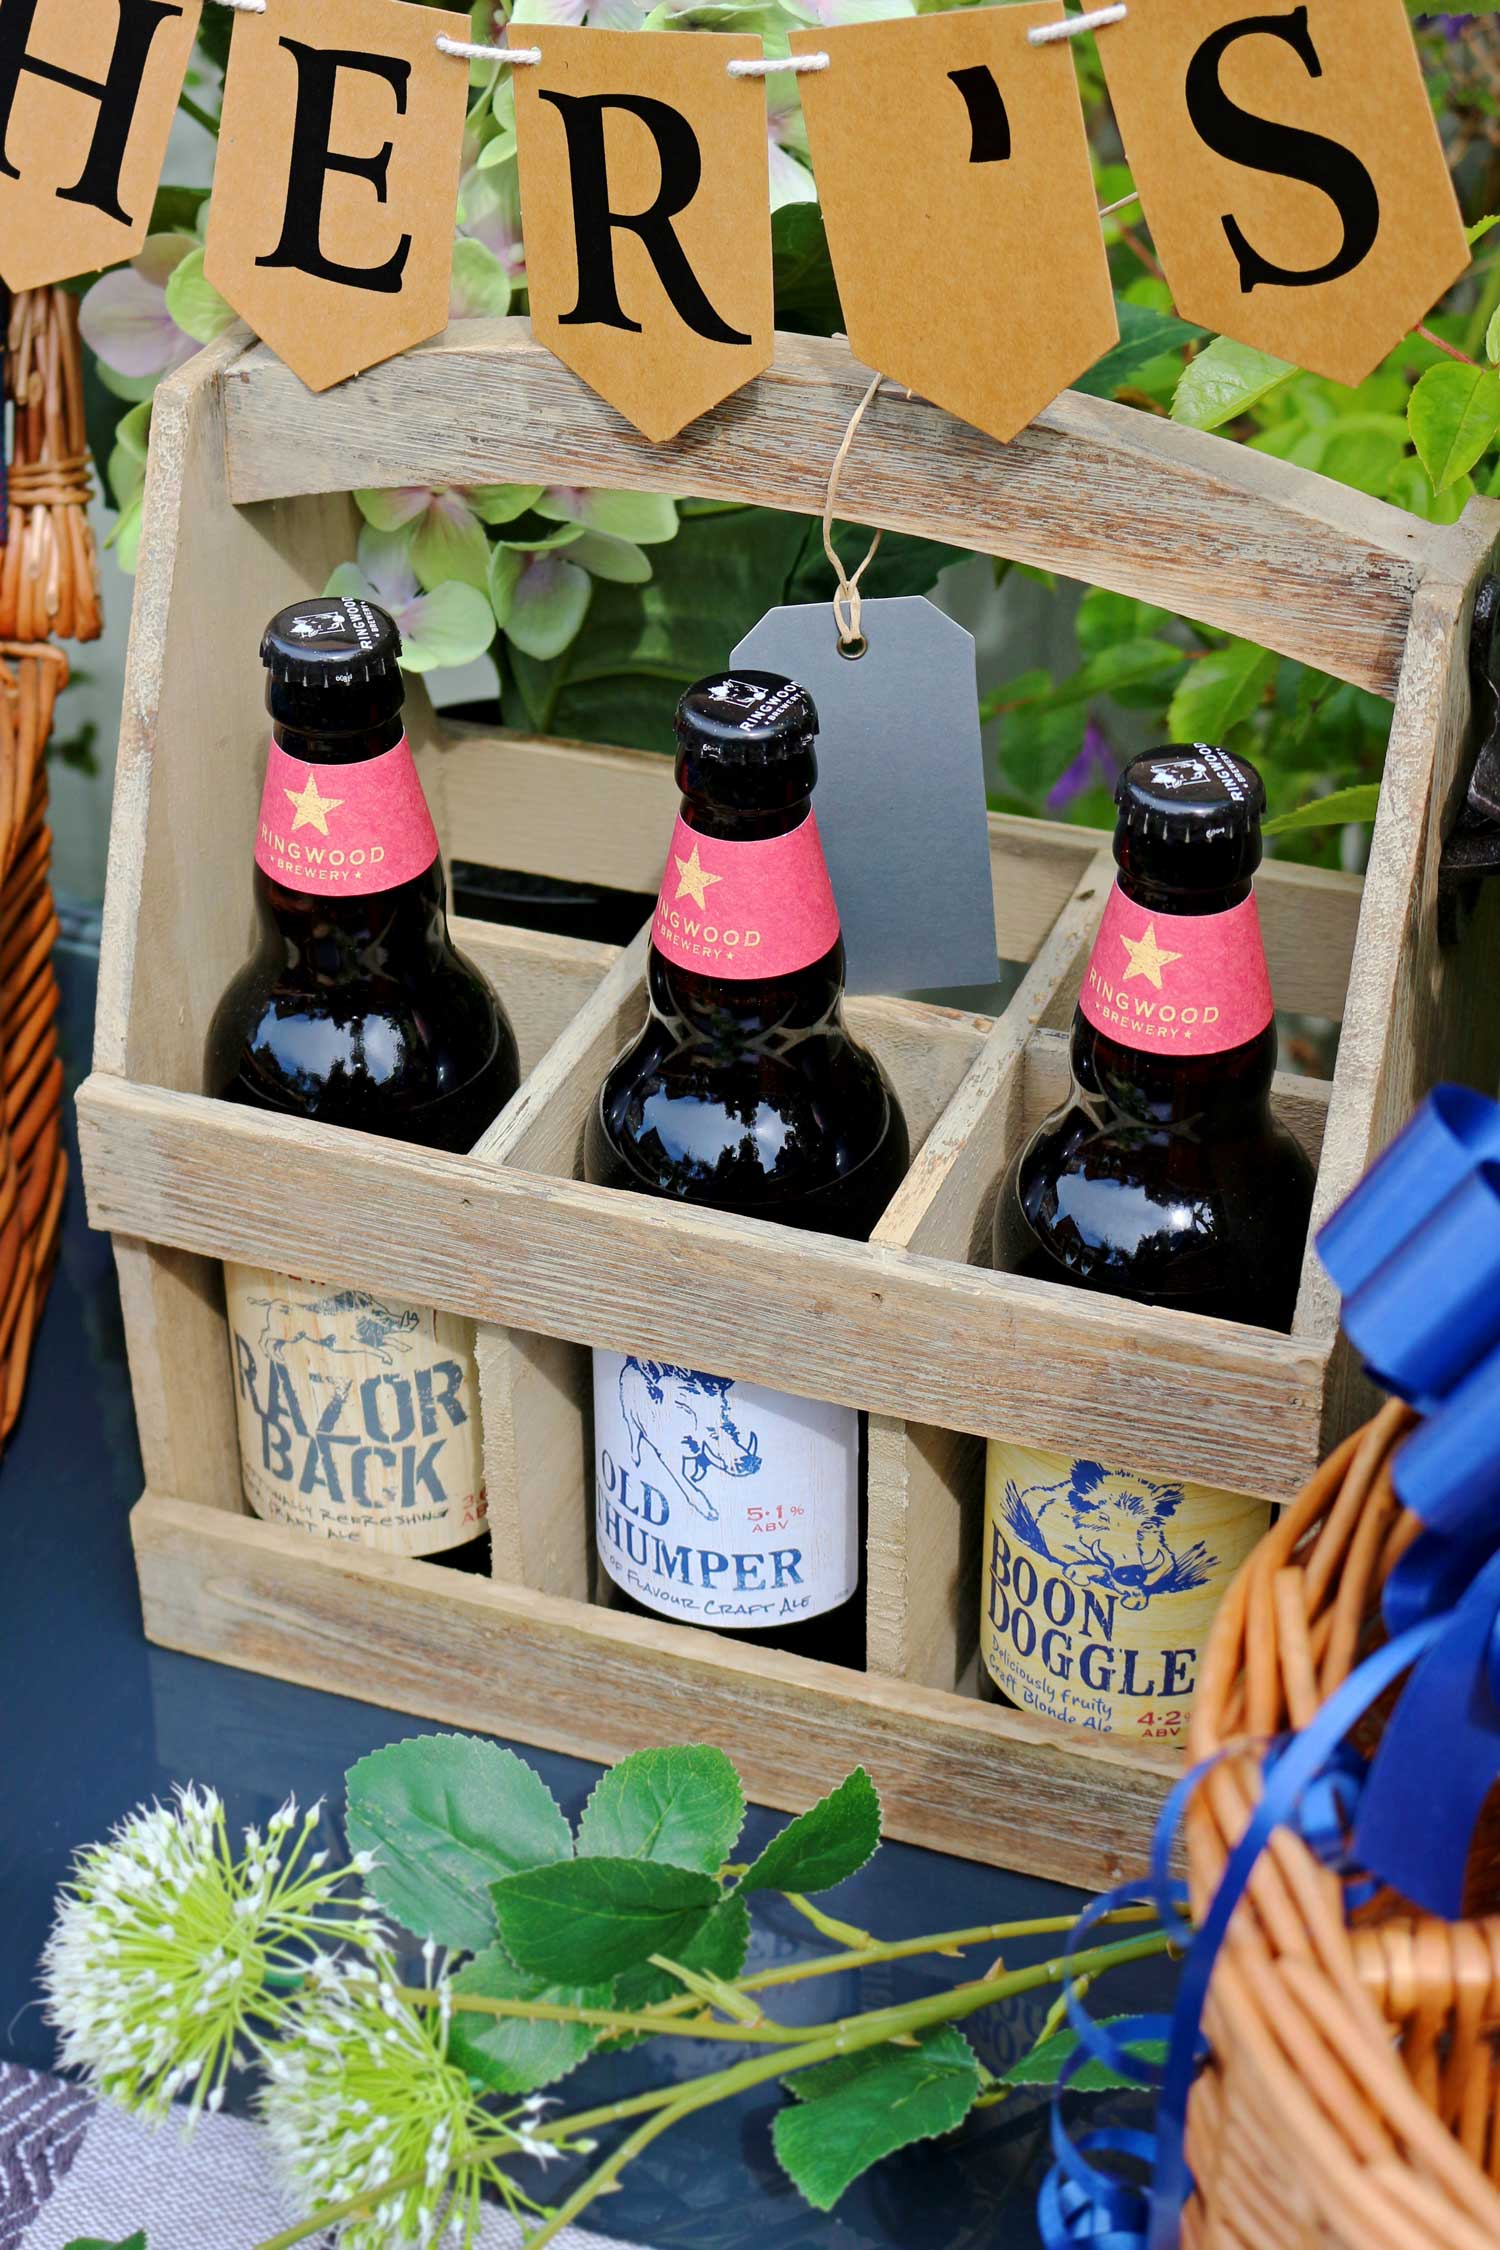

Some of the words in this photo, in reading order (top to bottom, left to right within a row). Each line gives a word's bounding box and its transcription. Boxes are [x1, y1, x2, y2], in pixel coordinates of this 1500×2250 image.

[767, 692, 802, 721] BREWERY
[1193, 742, 1245, 801] RINGWOOD
[261, 823, 385, 866] RINGWOOD
[277, 858, 349, 881] BREWERY
[657, 887, 761, 948] INGWOOD
[660, 924, 722, 960] BREWERY
[1089, 967, 1219, 1024] RINGWOOD
[1102, 1006, 1178, 1039] BREWERY
[235, 1332, 468, 1446] RAZOR
[261, 1410, 448, 1508] BACK
[602, 1449, 670, 1526] OLD
[752, 1519, 789, 1533] ABV
[990, 1519, 1119, 1642] BOON
[988, 1568, 1197, 1697] DOGGLE
[989, 1653, 1016, 1695] Craft
[1023, 1685, 1077, 1724] Blonde
[1083, 1716, 1112, 1733] Ale
[993, 1634, 1055, 1703] Deliciously
[1142, 1727, 1181, 1738] ABV
